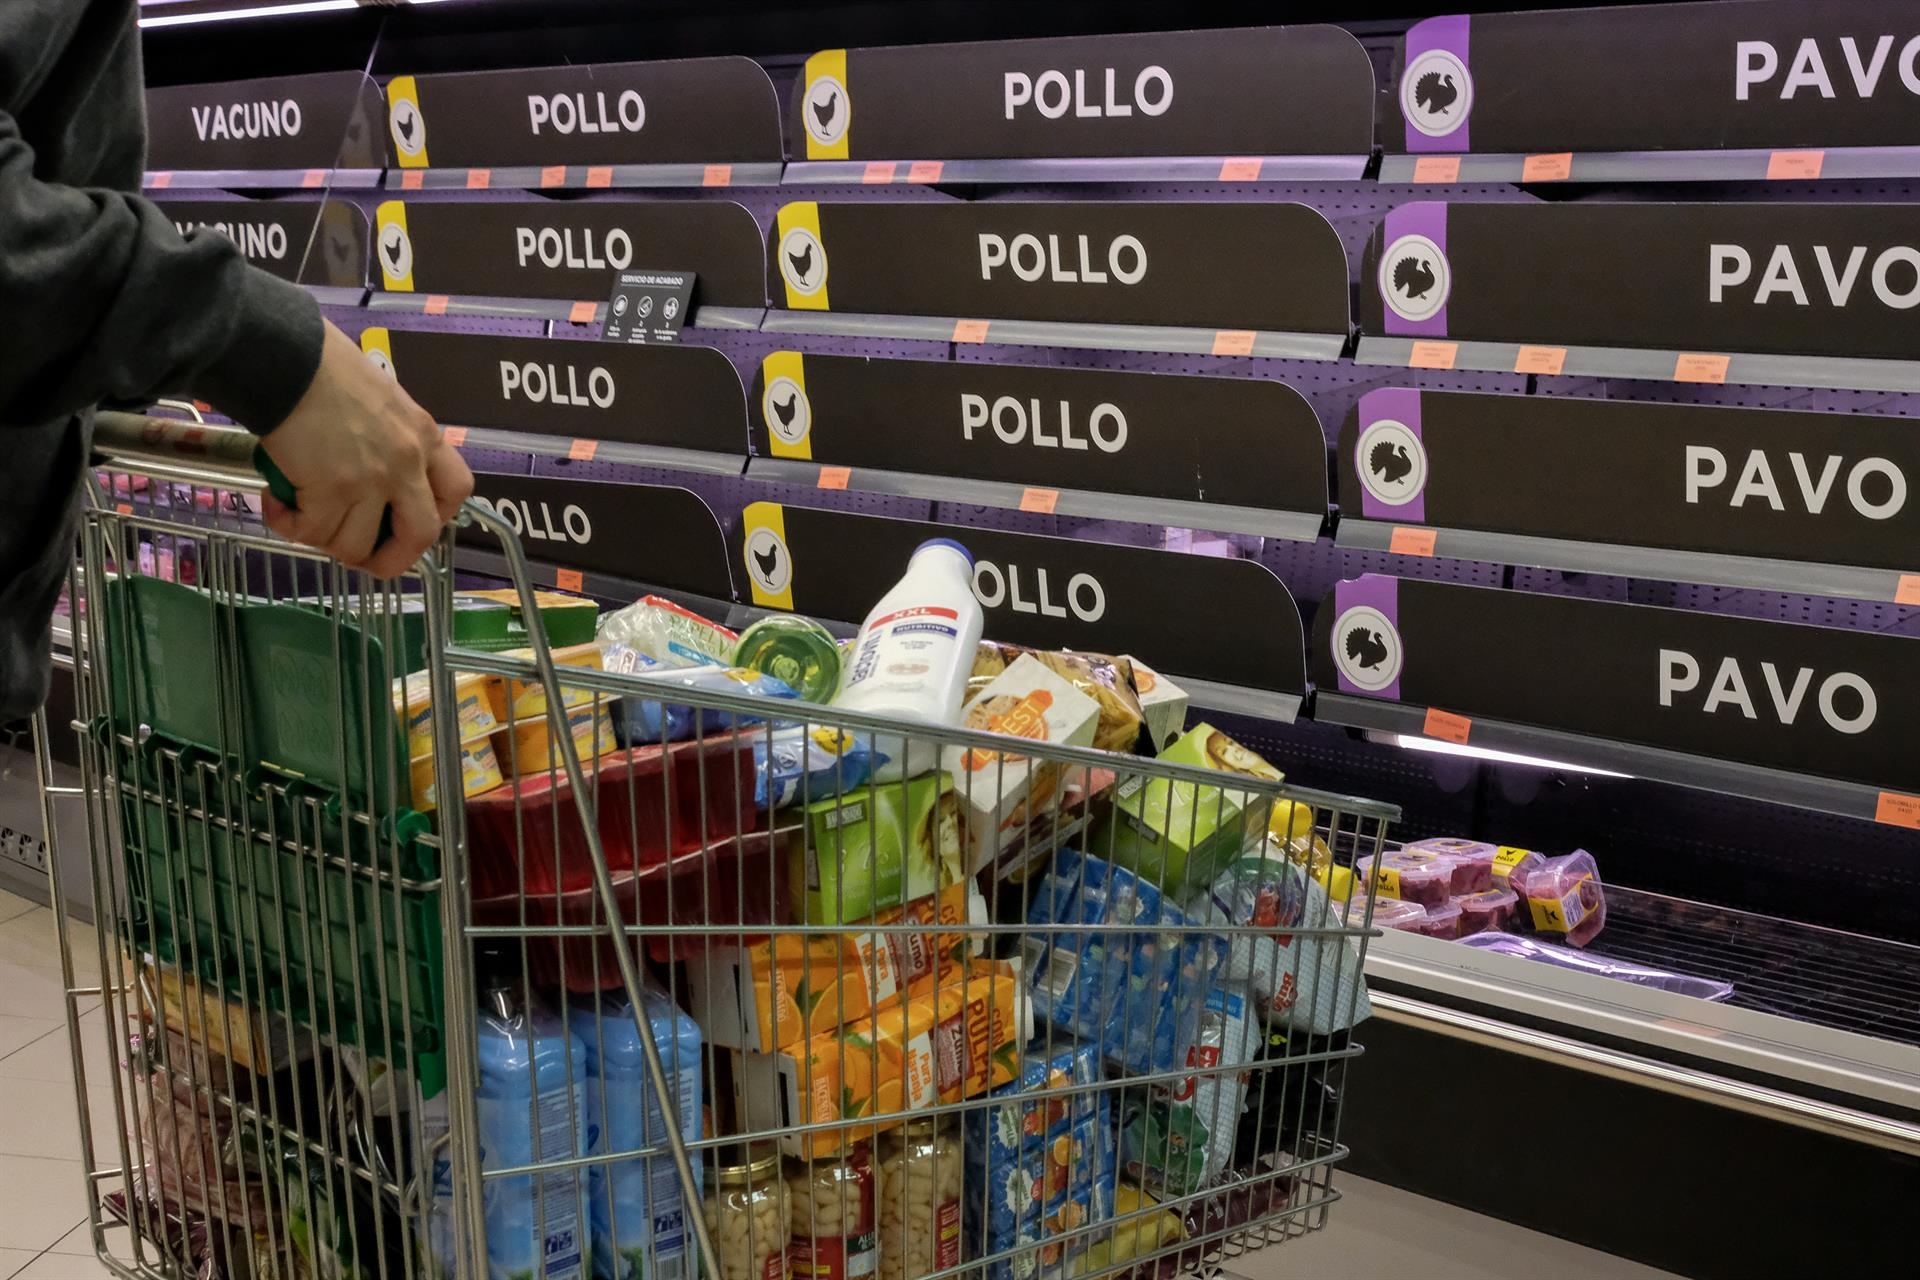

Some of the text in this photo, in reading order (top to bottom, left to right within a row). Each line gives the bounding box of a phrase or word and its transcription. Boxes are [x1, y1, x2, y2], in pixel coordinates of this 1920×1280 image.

[527, 89, 646, 135] POLLO
[1005, 65, 1174, 120] POLLO
[191, 99, 302, 142] VACUNO
[175, 221, 288, 260] UNO
[516, 227, 633, 271] POLLO
[978, 233, 1148, 285] POLLO
[1709, 243, 1920, 308] PAVO
[499, 360, 616, 409] POLLO
[960, 393, 1128, 453] POLLO
[1685, 445, 1907, 520] PAVO
[893, 607, 932, 621] XXL
[971, 559, 1106, 623] OLLO
[896, 622, 950, 634] NUTRITIVO
[1659, 648, 1877, 734] PAVO
